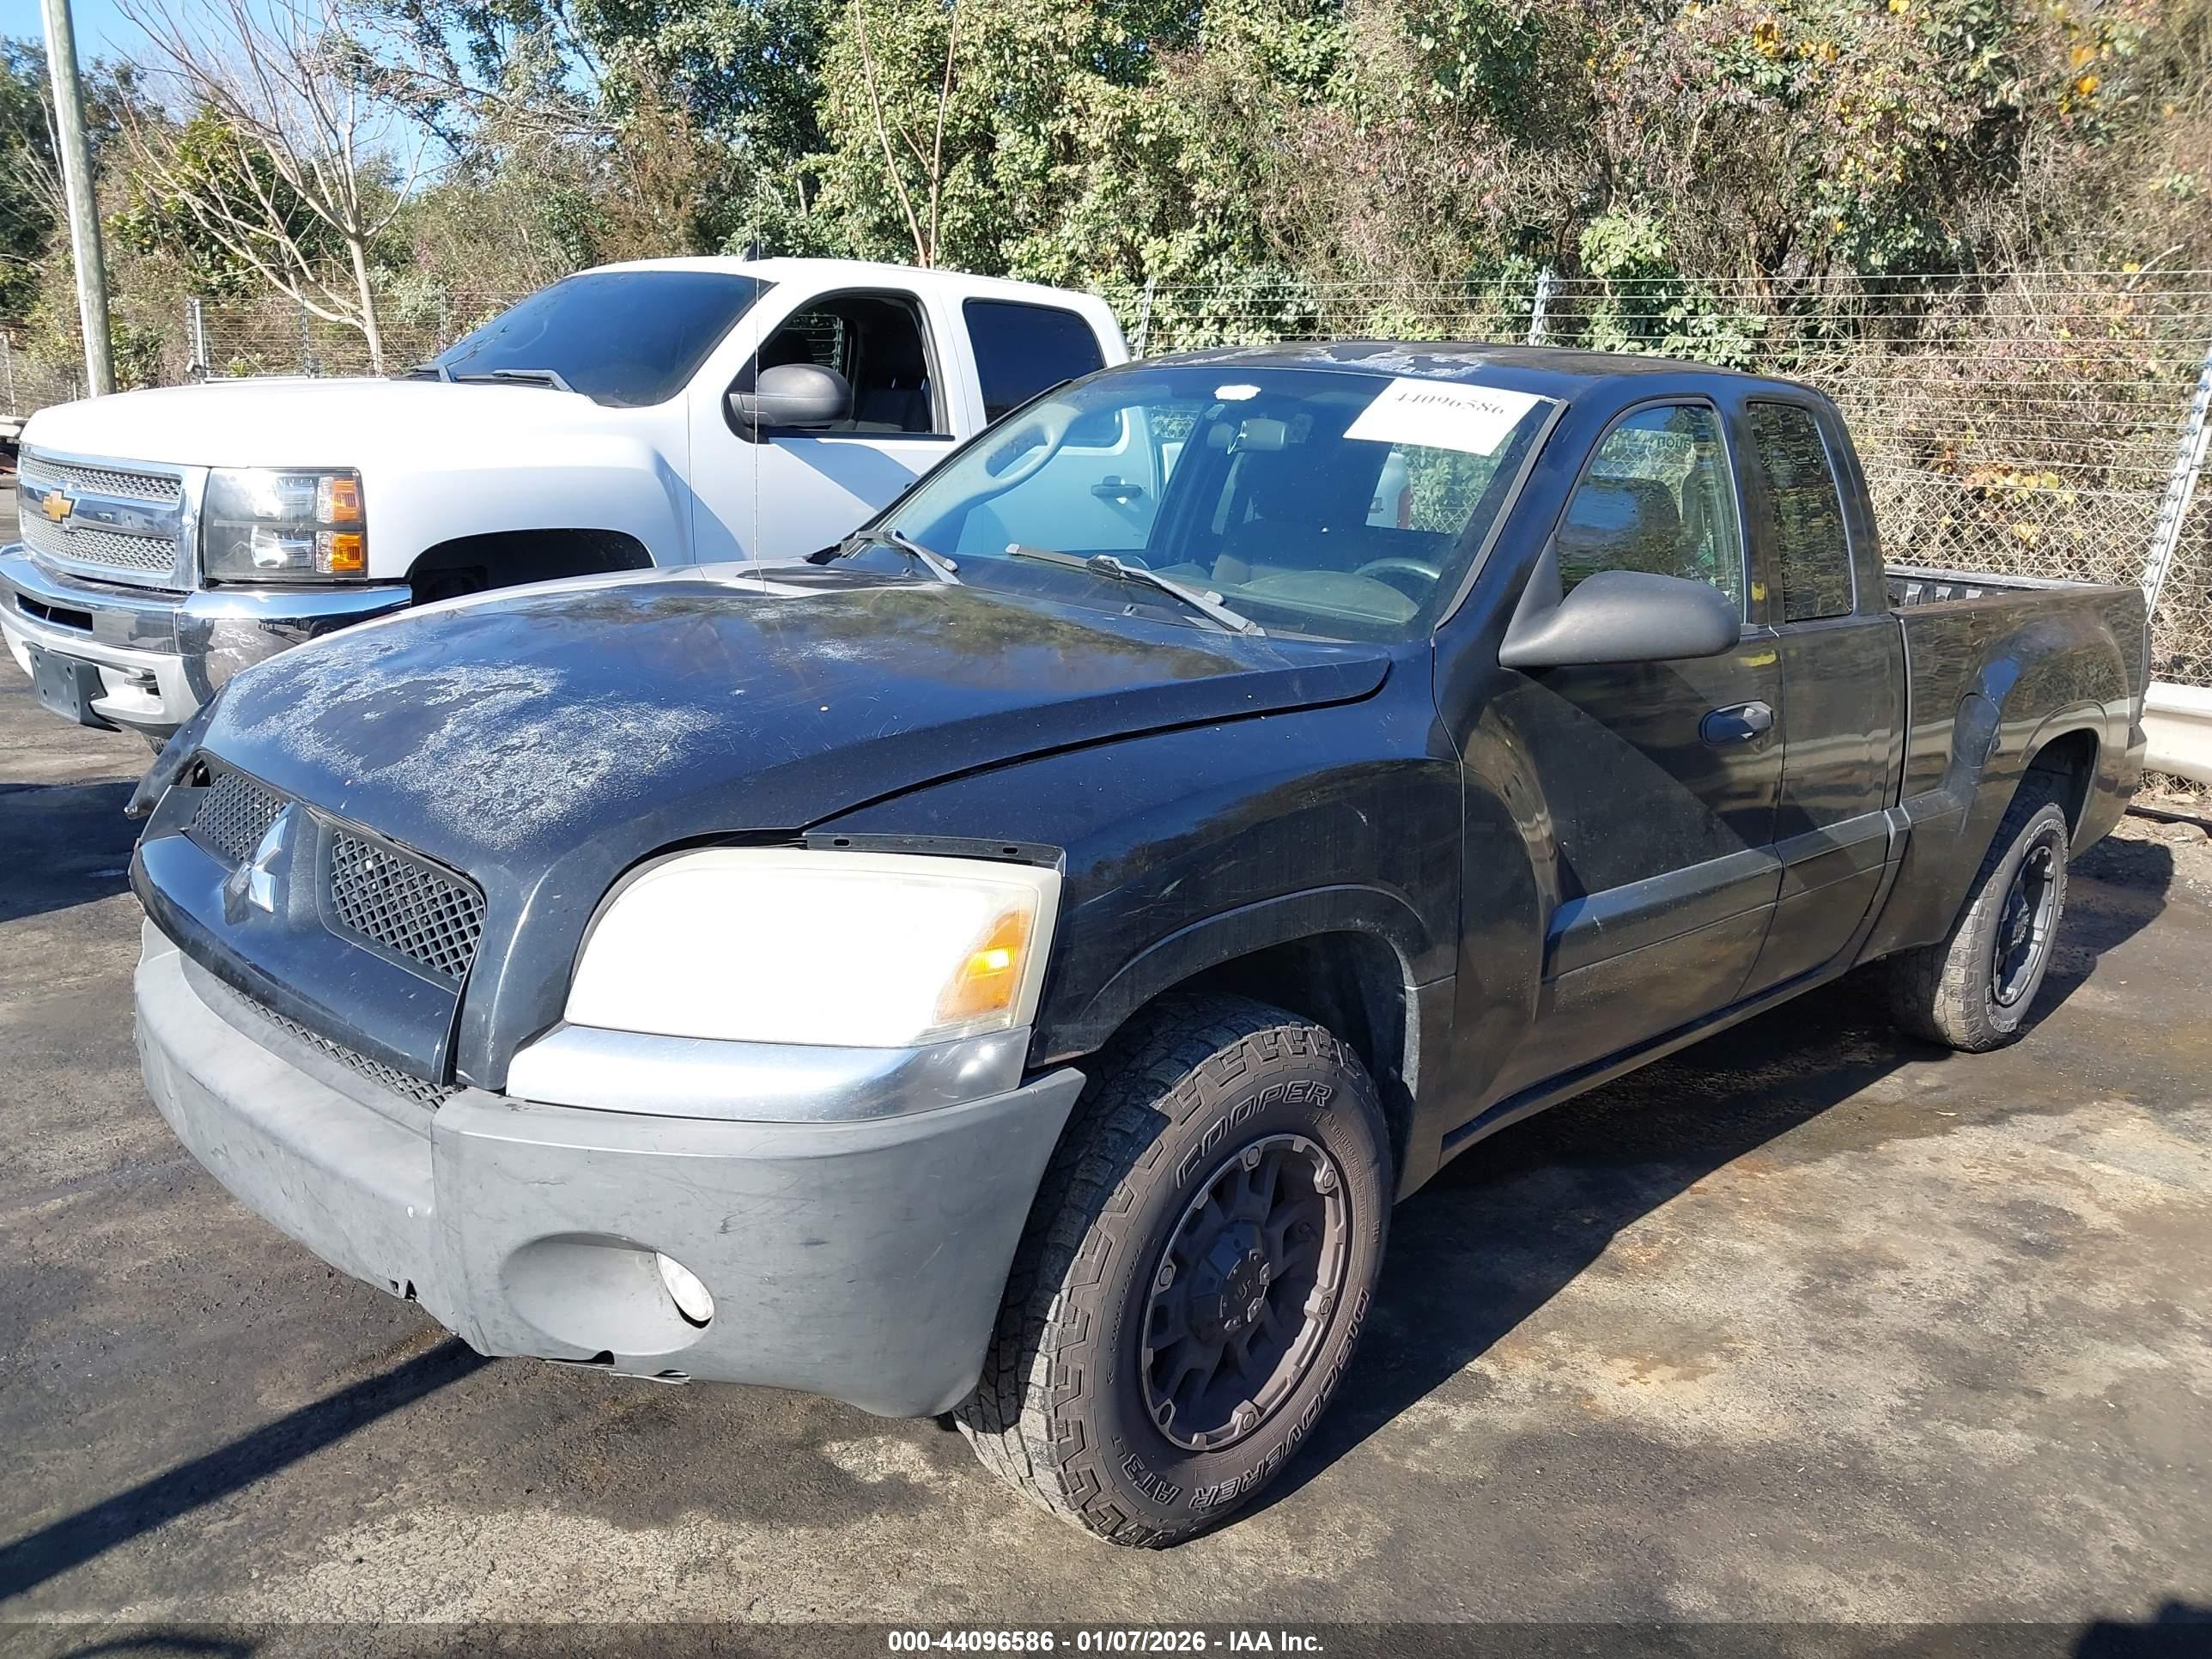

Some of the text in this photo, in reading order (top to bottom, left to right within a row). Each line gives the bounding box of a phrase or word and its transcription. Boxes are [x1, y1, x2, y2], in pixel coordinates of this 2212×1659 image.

[1395, 392, 1504, 414] 44096586
[1176, 1080, 1333, 1189] COOPER
[1188, 1286, 1370, 1511] DISCOVERER
